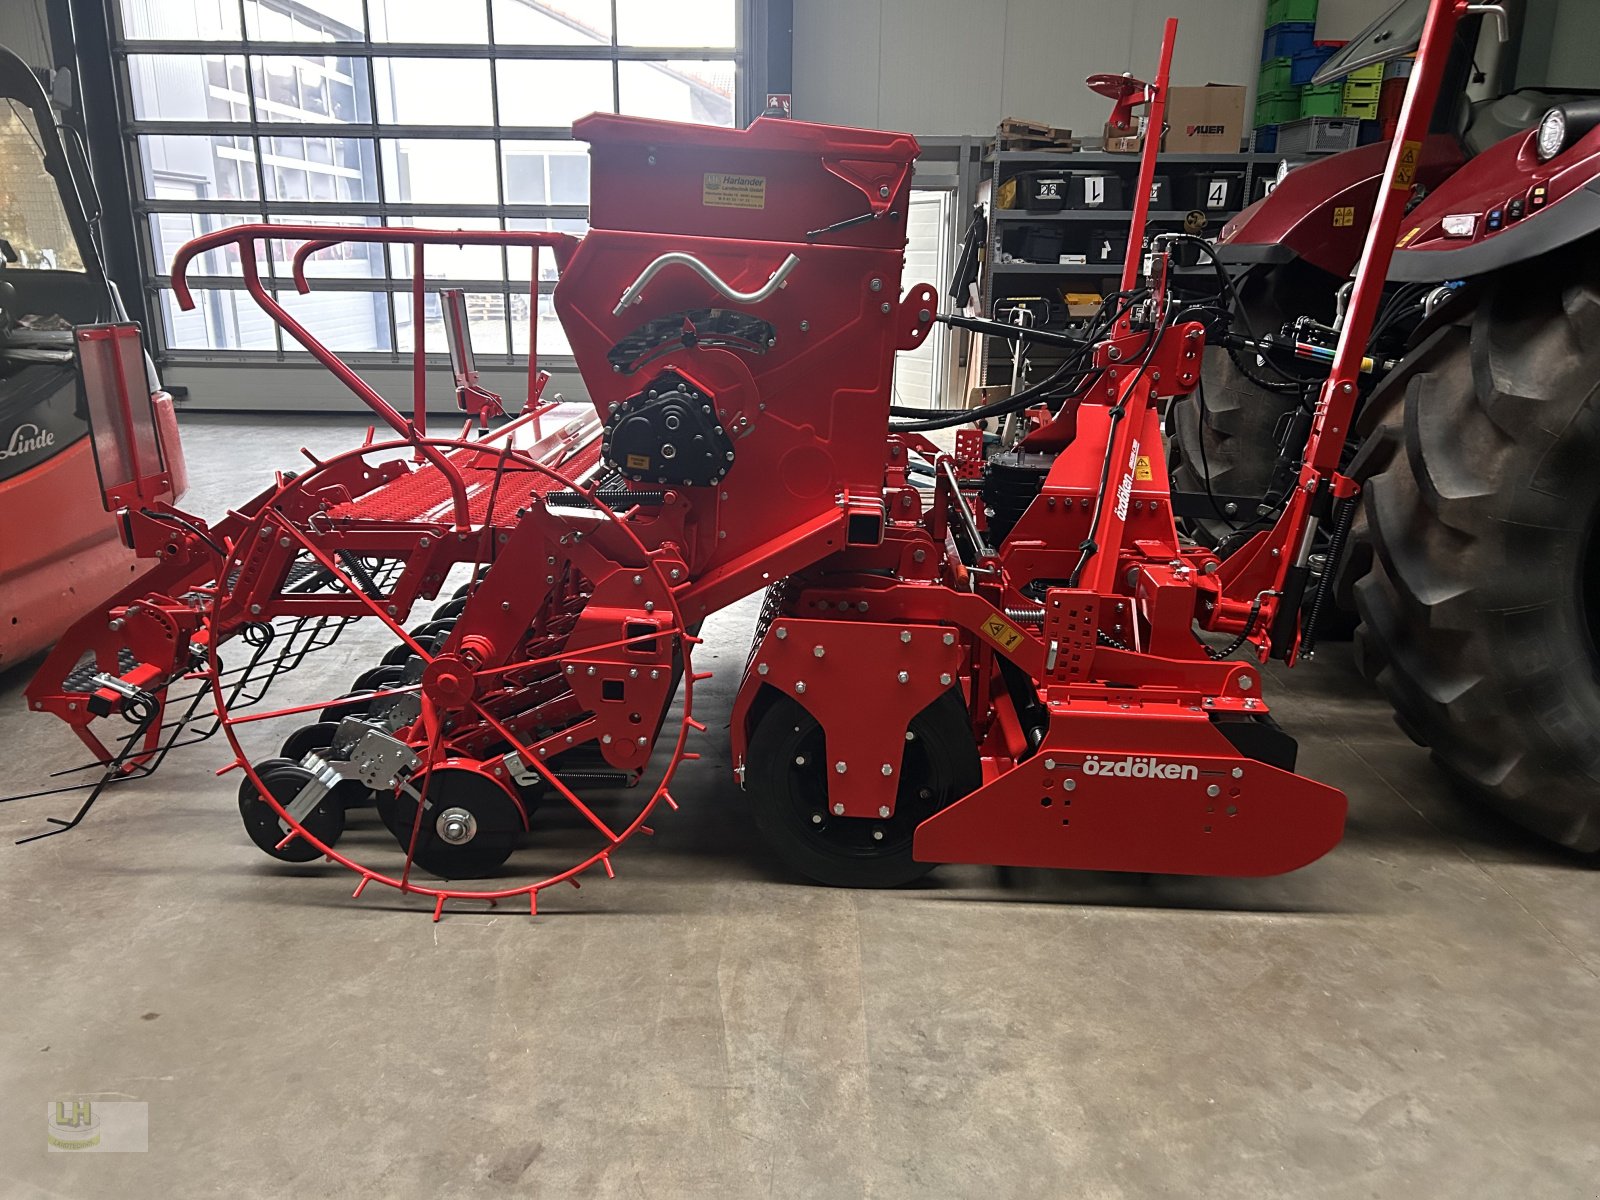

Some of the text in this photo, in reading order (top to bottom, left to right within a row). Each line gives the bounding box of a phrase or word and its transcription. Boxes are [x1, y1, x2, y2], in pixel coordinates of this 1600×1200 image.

[722, 175, 764, 186] Harlander
[1041, 184, 1057, 196] 26
[1209, 184, 1224, 205] 4
[0, 423, 56, 460] Linde
[1114, 472, 1134, 522] özdöken
[1083, 755, 1199, 781] özdöken
